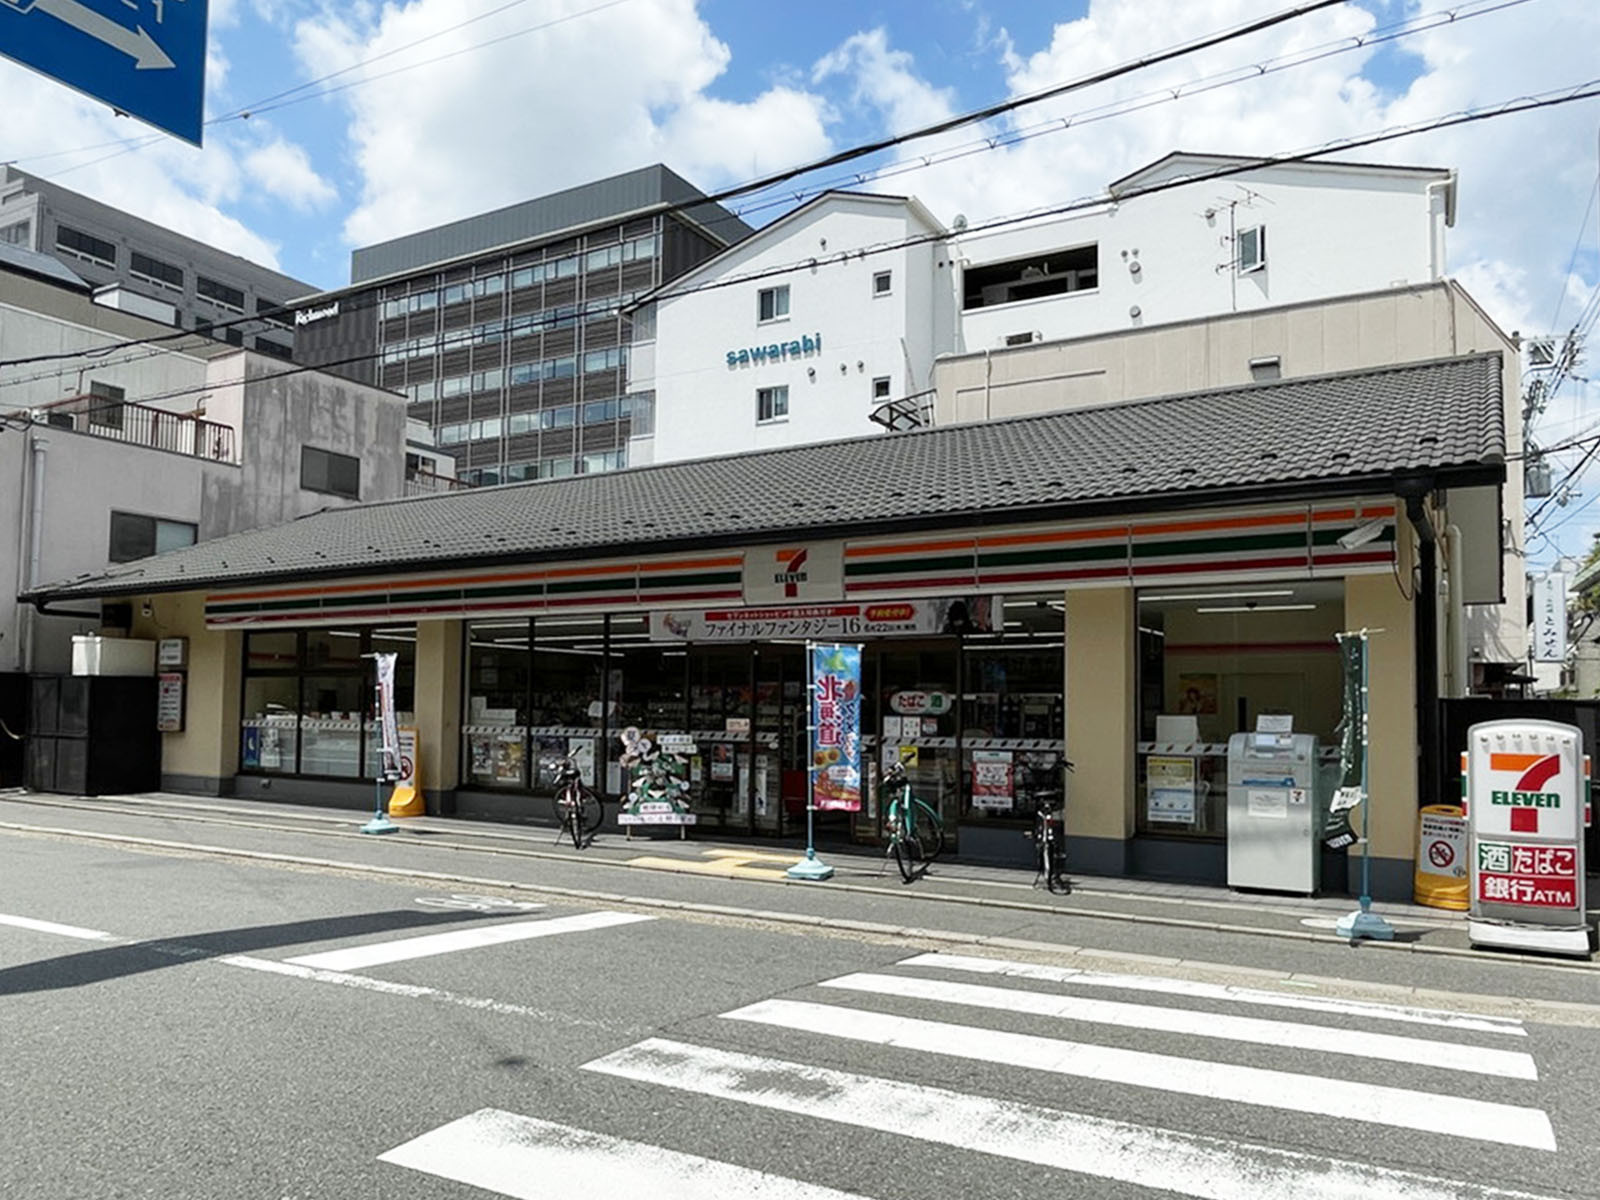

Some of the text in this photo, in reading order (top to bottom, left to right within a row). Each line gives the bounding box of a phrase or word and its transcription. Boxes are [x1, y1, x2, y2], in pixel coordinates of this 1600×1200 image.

[726, 332, 822, 366] sawarabi
[776, 548, 807, 598] 7
[704, 617, 862, 638] ファイナルファンタジー16
[898, 695, 926, 708] たばこ
[1490, 753, 1560, 834] 7
[1481, 844, 1574, 875] 酒 たばこ
